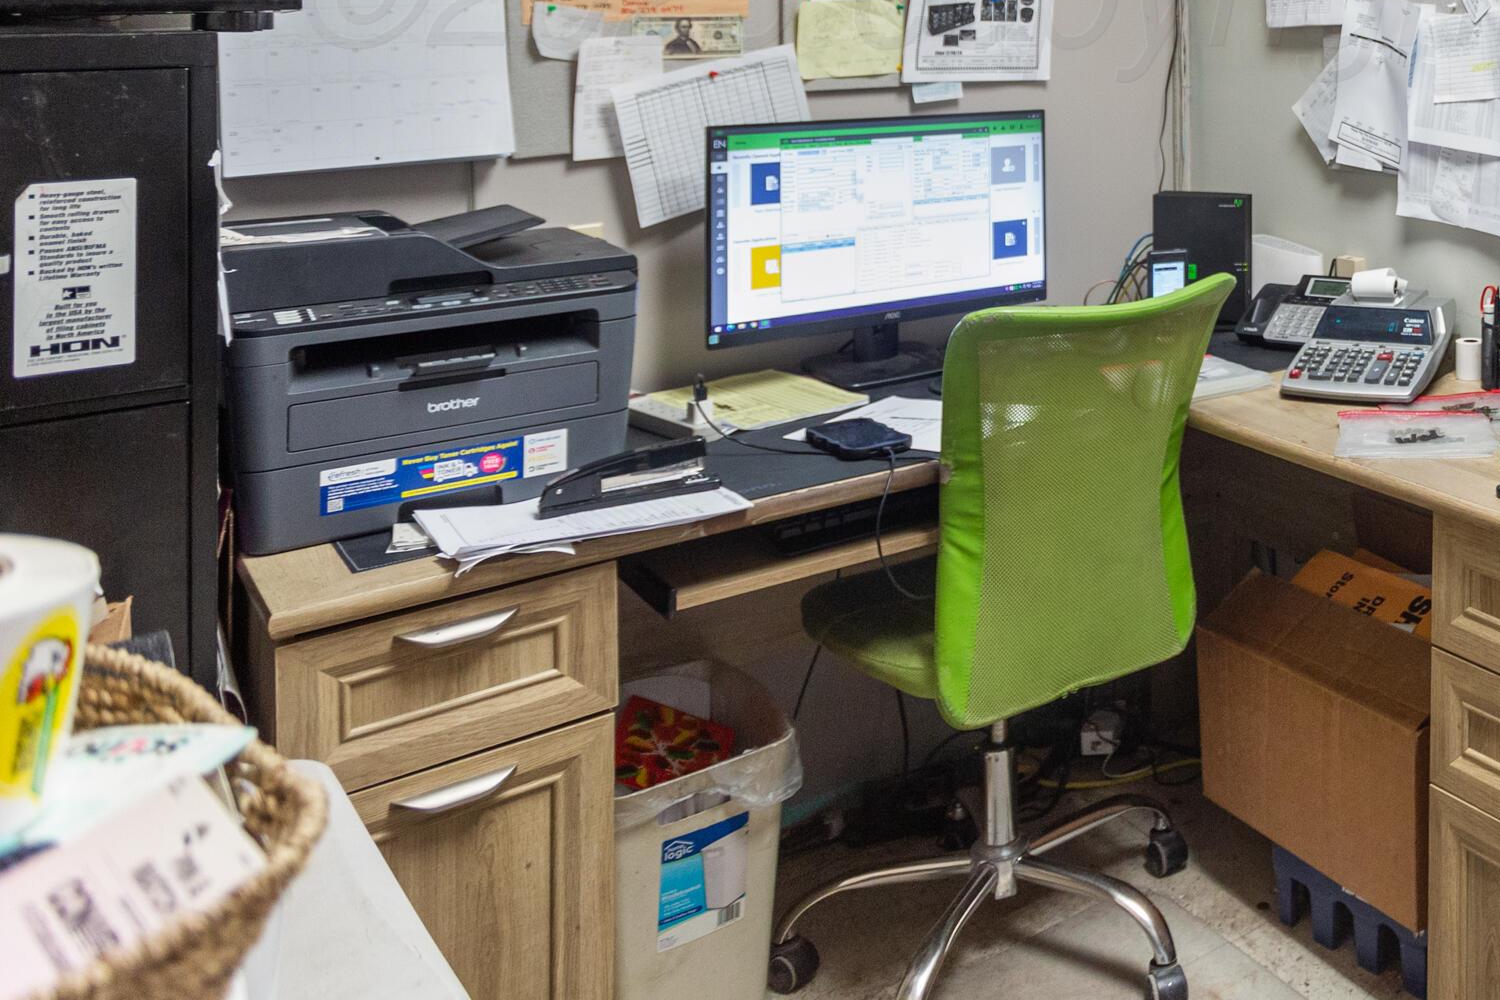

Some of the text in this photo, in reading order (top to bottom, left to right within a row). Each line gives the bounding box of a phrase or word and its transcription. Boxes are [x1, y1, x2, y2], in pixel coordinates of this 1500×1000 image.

[30, 336, 120, 357] HON
[427, 397, 480, 413] brother
[664, 846, 695, 861] logic
